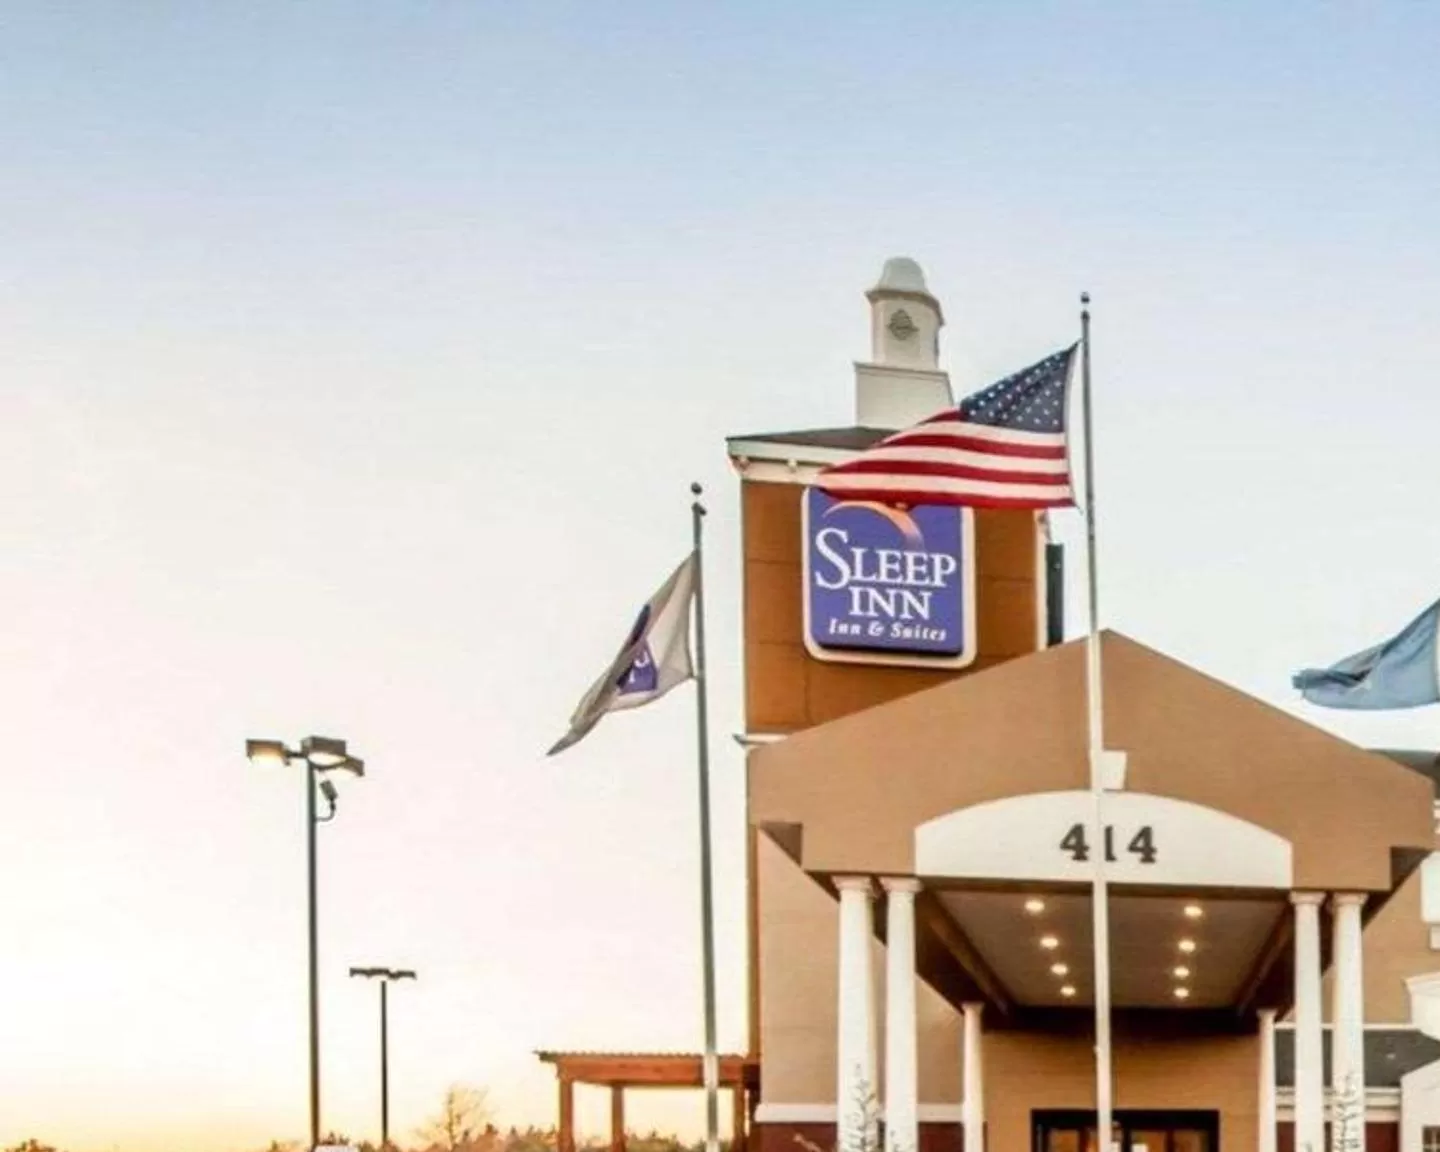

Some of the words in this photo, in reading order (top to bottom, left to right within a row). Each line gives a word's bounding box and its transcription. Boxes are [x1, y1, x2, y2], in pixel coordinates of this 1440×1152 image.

[815, 527, 956, 589] SLEEP
[849, 586, 932, 620] INN
[829, 618, 861, 635] Inn
[868, 621, 885, 637] &
[890, 621, 947, 641] Suites
[1059, 822, 1157, 864] 414
